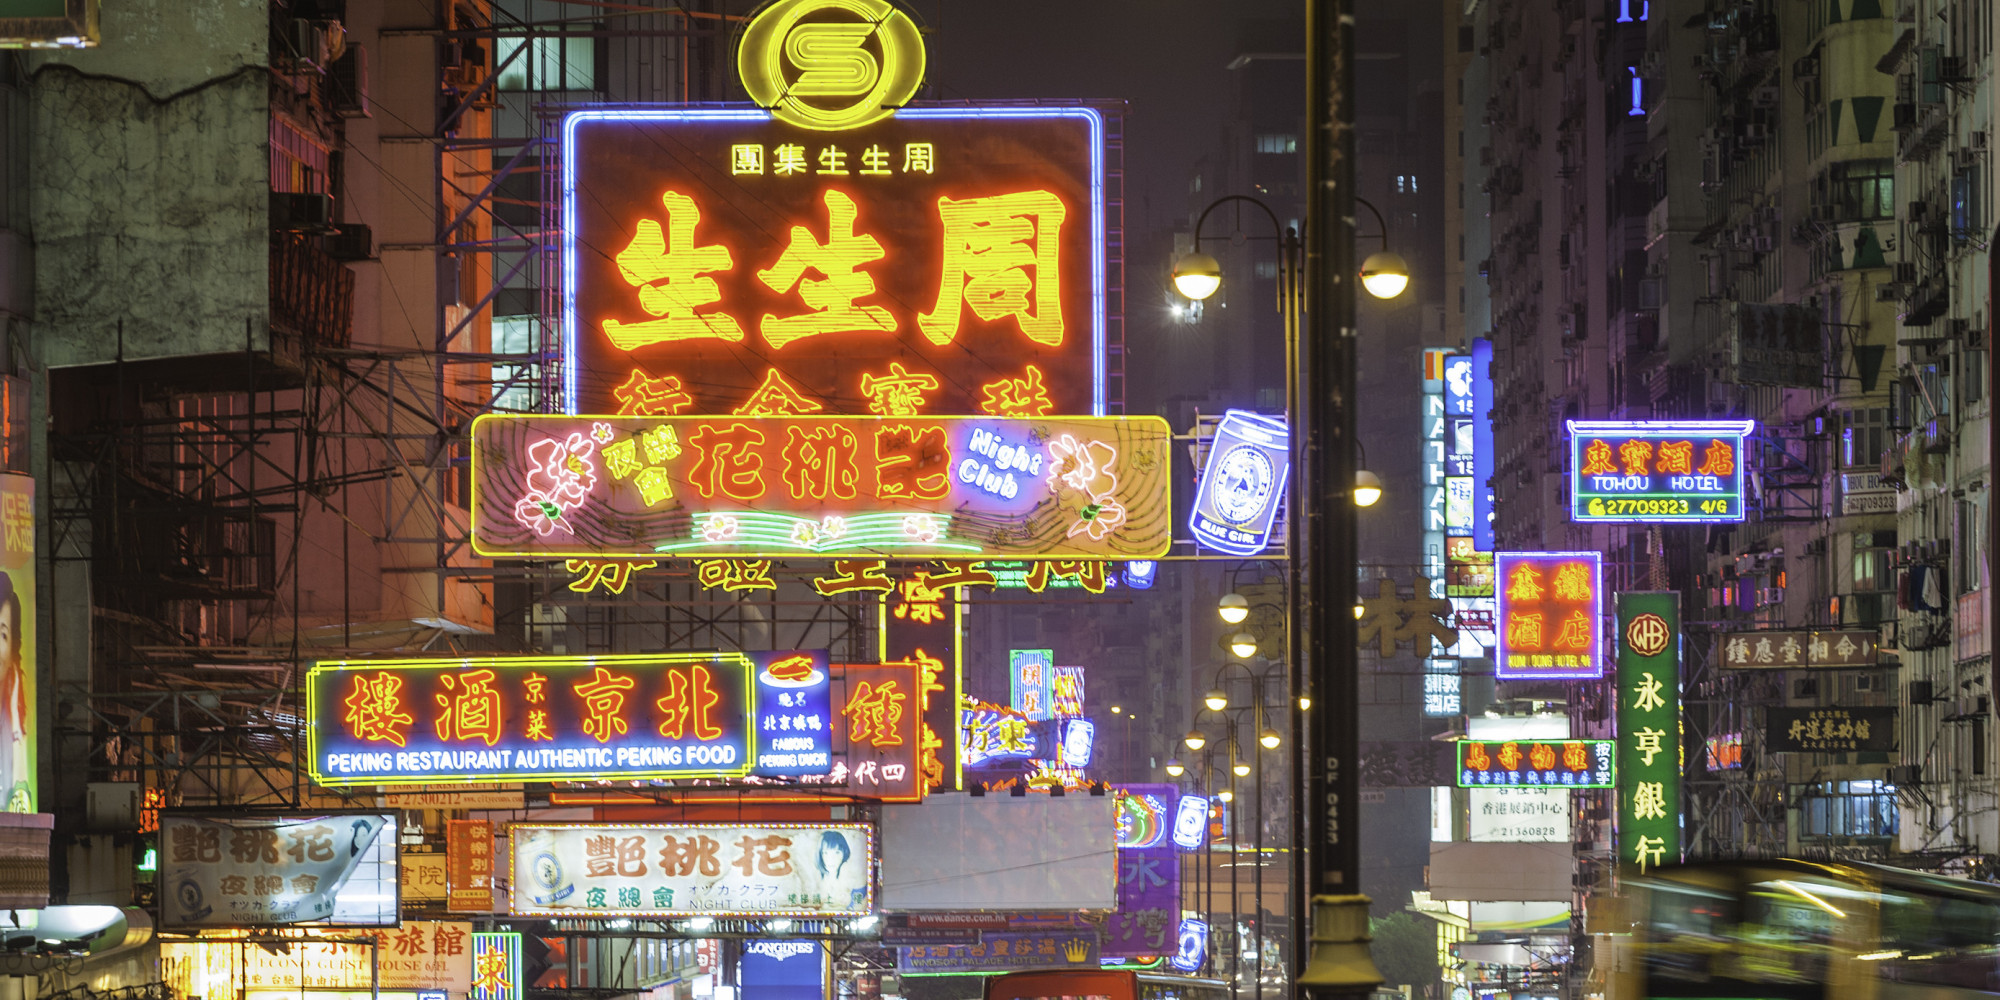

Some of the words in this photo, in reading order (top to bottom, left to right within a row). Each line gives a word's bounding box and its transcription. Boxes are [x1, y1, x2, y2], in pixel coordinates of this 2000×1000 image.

[731, 142, 935, 176] 周生生集團
[602, 189, 1066, 350] 周生生
[967, 427, 1044, 477] Night
[1581, 438, 1735, 476] 東寶酒店
[957, 459, 1020, 500] Club
[1592, 476, 1650, 491] TOHOU
[1671, 476, 1724, 491] HOTEL
[1606, 499, 1690, 515] 27709323
[1199, 518, 1228, 538] BLUE
[1228, 530, 1256, 545] GIRL
[1507, 609, 1592, 649] 酒店
[344, 669, 501, 748] 酒樓
[574, 664, 722, 743] 北京
[771, 736, 815, 751] FAMOUS
[327, 752, 393, 773] PEKING
[396, 750, 512, 772] RESTAURANT
[515, 746, 613, 769] AUTHENTIC
[616, 746, 683, 767] PEKING
[686, 744, 736, 765] FOOD
[758, 753, 798, 769] PEKING
[798, 752, 828, 767] DUCK
[1326, 757, 1339, 784] DF
[1632, 671, 1668, 876] 永亨銀行
[403, 792, 461, 805] 27300212
[1501, 827, 1556, 837] 21360828
[586, 886, 675, 909] 夜總會
[689, 899, 733, 910] NIGHT
[739, 899, 778, 910] CLUB
[230, 913, 266, 922] NIGHT
[747, 942, 815, 954] LONGINES
[317, 959, 366, 972] GUEST
[910, 957, 958, 967] WINDSOR
[961, 957, 1004, 966] PALACE
[1007, 956, 1042, 965] HOTEL
